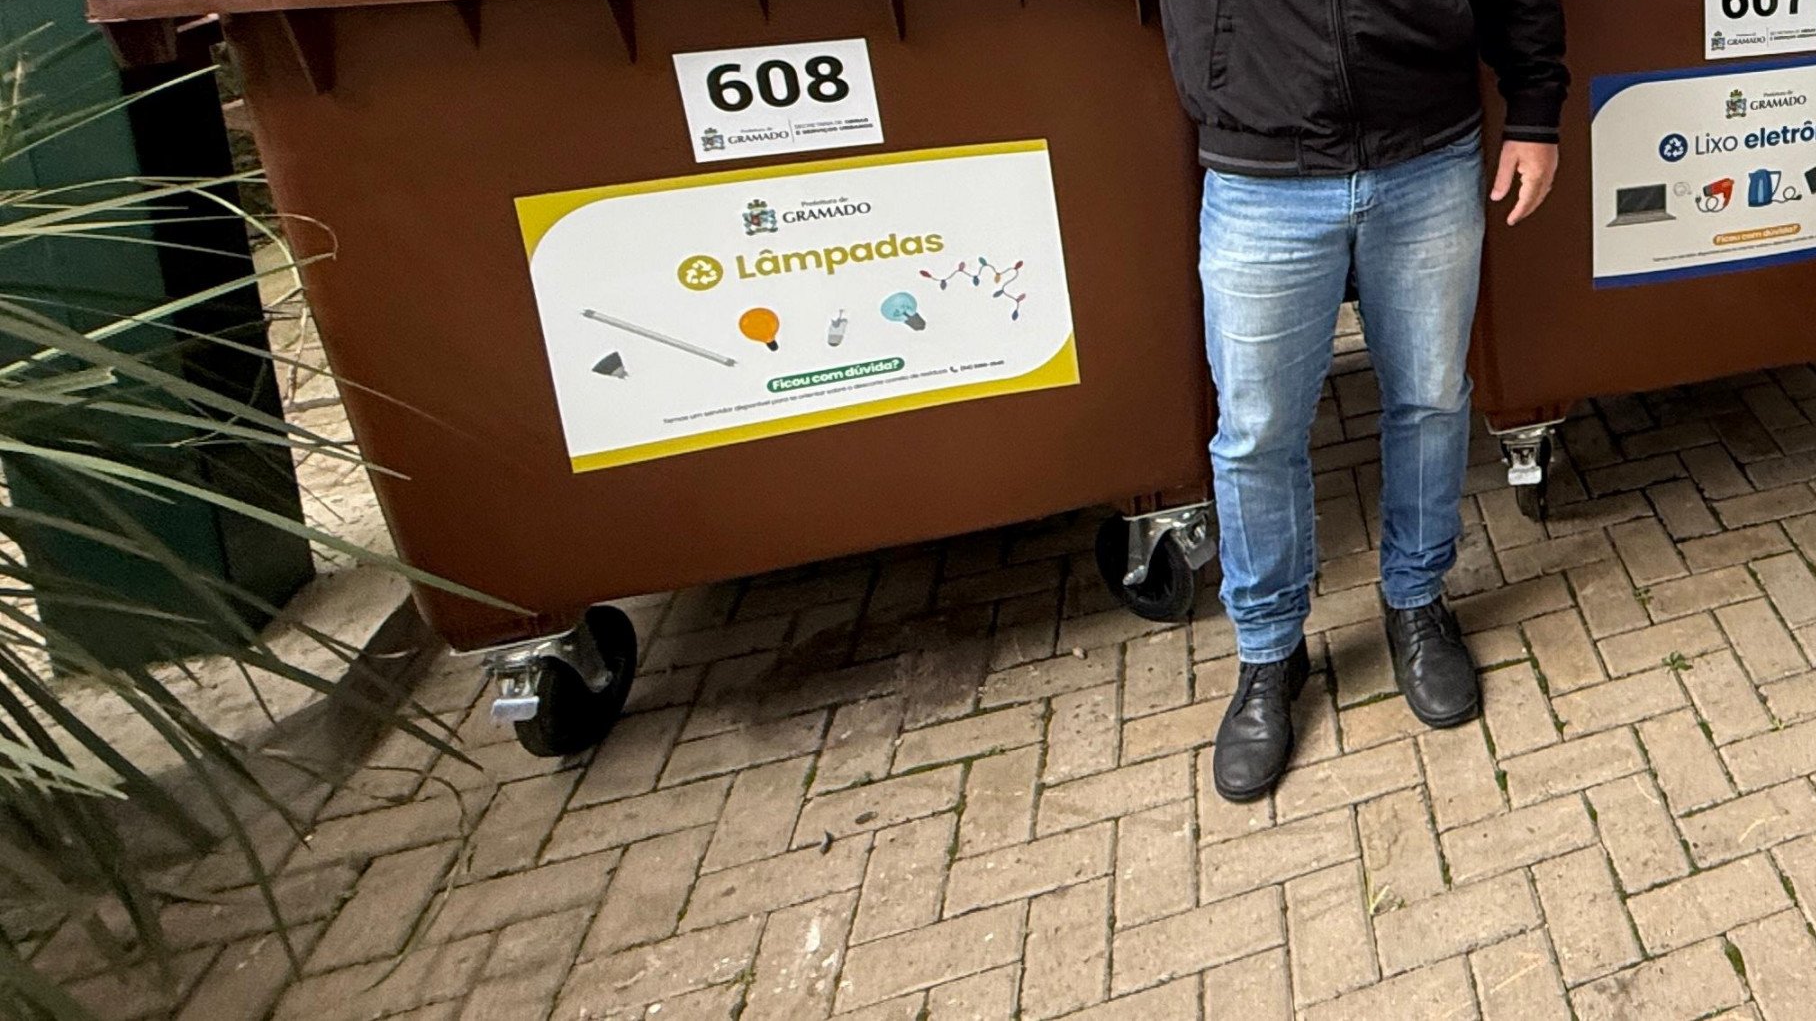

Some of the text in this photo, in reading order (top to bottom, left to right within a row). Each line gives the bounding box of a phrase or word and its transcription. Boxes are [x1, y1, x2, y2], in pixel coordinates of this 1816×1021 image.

[1727, 36, 1766, 46] GRAMADO
[706, 55, 850, 112] 608
[1750, 94, 1807, 111] GRAMADO
[727, 130, 789, 145] GRAMADO
[1695, 133, 1738, 155] Lixo
[801, 196, 848, 207] Prefeitura de
[782, 201, 872, 224] GRAMADO
[1716, 233, 1740, 243] Ficou
[1741, 232, 1762, 241] com
[735, 233, 945, 279] Lâmpadas
[772, 359, 899, 390] Ficou com dúvida?
